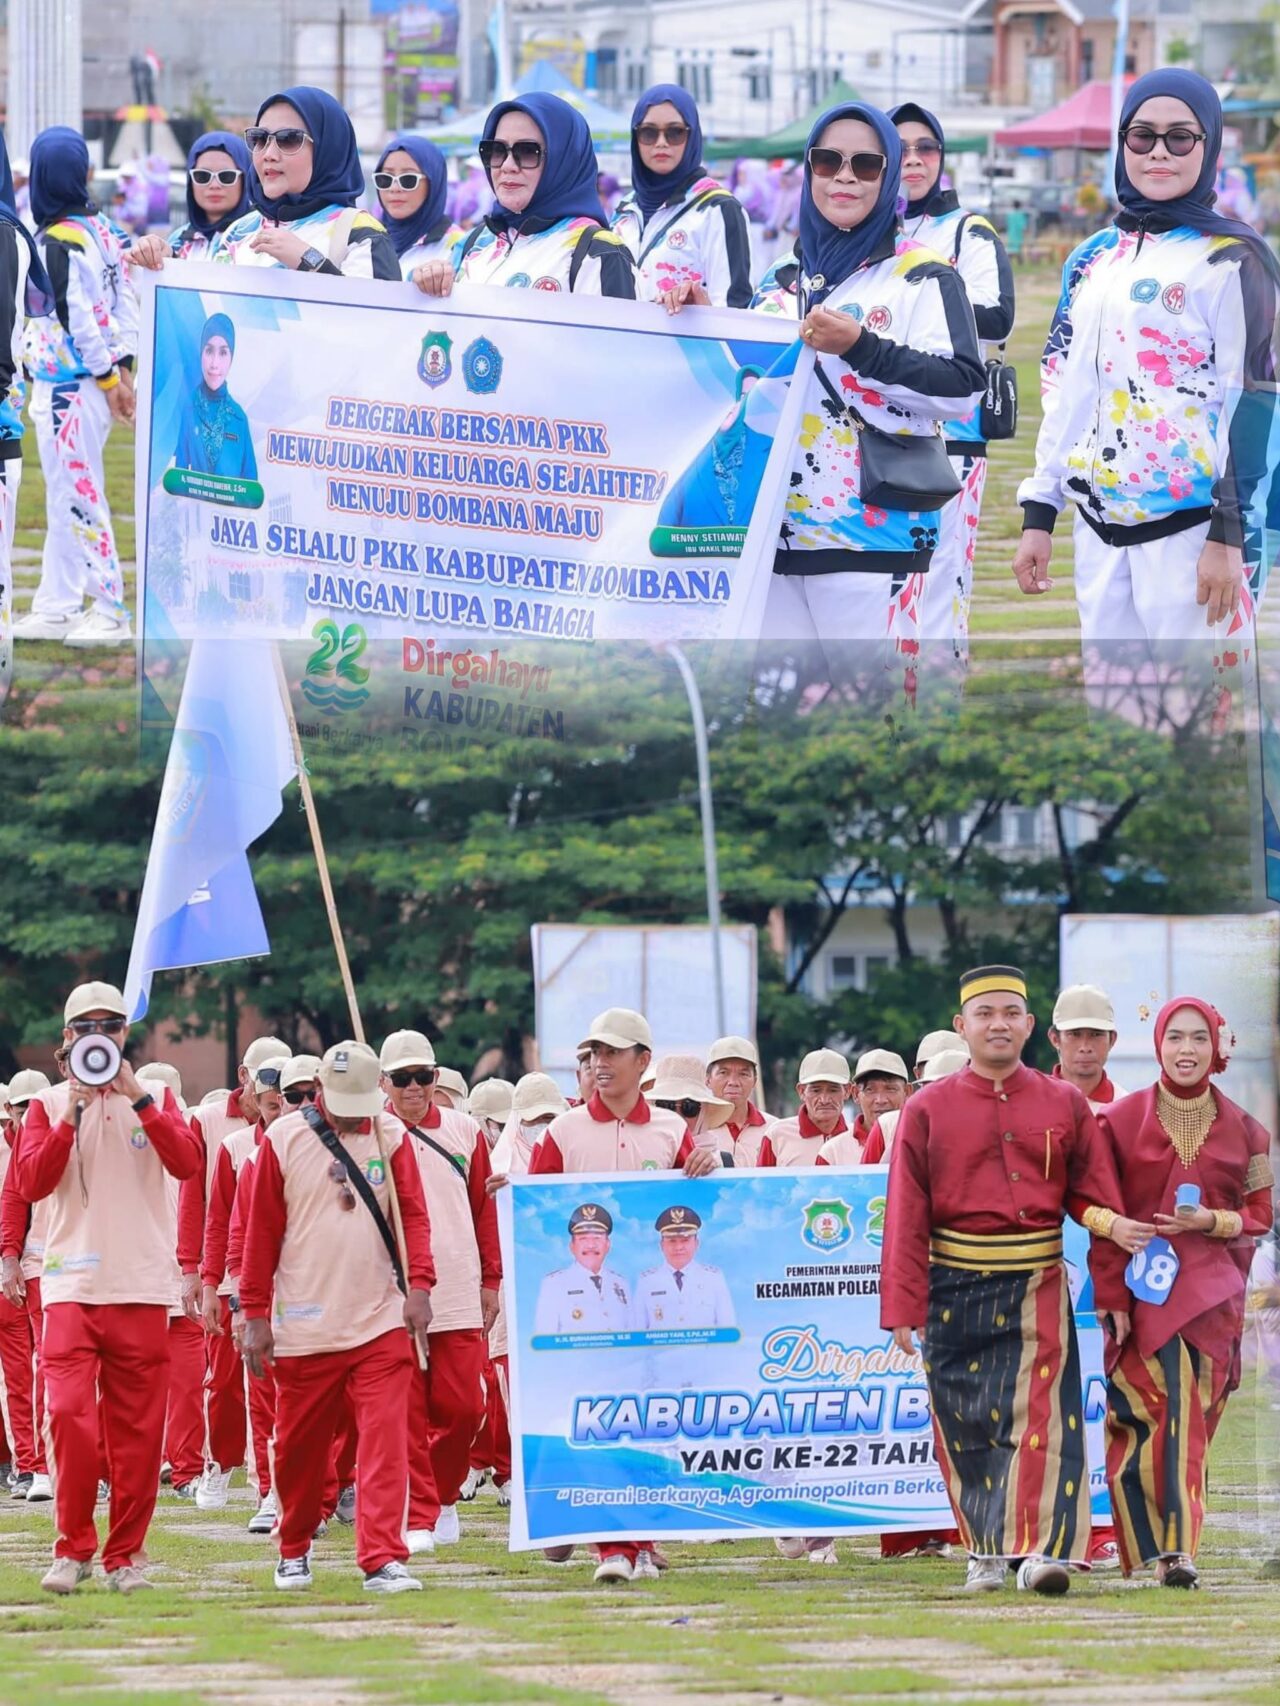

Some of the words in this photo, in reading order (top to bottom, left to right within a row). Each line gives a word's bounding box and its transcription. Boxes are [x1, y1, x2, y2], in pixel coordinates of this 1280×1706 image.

[328, 399, 437, 438] BERGERAK
[440, 411, 553, 449] BERSAMA
[556, 423, 608, 454] PKK
[269, 432, 408, 476] MEWUJUDKAN
[412, 450, 531, 490] KELUARGA
[536, 462, 668, 501] SEJAHTERA
[329, 480, 411, 517] MENUJU
[416, 492, 530, 530] BOMBANA
[533, 505, 600, 538] MAJU
[210, 515, 259, 550] JAYA
[265, 523, 357, 564] SELALU
[363, 537, 420, 573] PKK
[424, 545, 592, 592] KABUPATEN
[588, 564, 732, 601] BOMBANA
[670, 533, 699, 543] HENNY
[699, 545, 721, 553] WAKIL
[307, 573, 409, 614] JANGAN
[415, 588, 487, 626] LUPA
[493, 597, 597, 640] BAHAGIA
[305, 618, 371, 685] 22
[402, 636, 553, 700] Dirgahayu
[403, 685, 565, 744] KABUPATEN
[867, 1197, 887, 1231] 2
[756, 1281, 835, 1299] KECAMATAN
[786, 1264, 841, 1278] PEMERINTAH
[842, 1263, 881, 1275] KABUPAT
[764, 1326, 929, 1385] Dirgahay
[572, 1388, 883, 1442] KABUPATEN
[680, 1448, 764, 1473] YANG
[773, 1445, 857, 1469] KE-22
[867, 1441, 939, 1466] TAH
[641, 1486, 725, 1507] Berkarya,
[731, 1480, 889, 1505] Agrominopolitan
[893, 1473, 946, 1495] Berke
